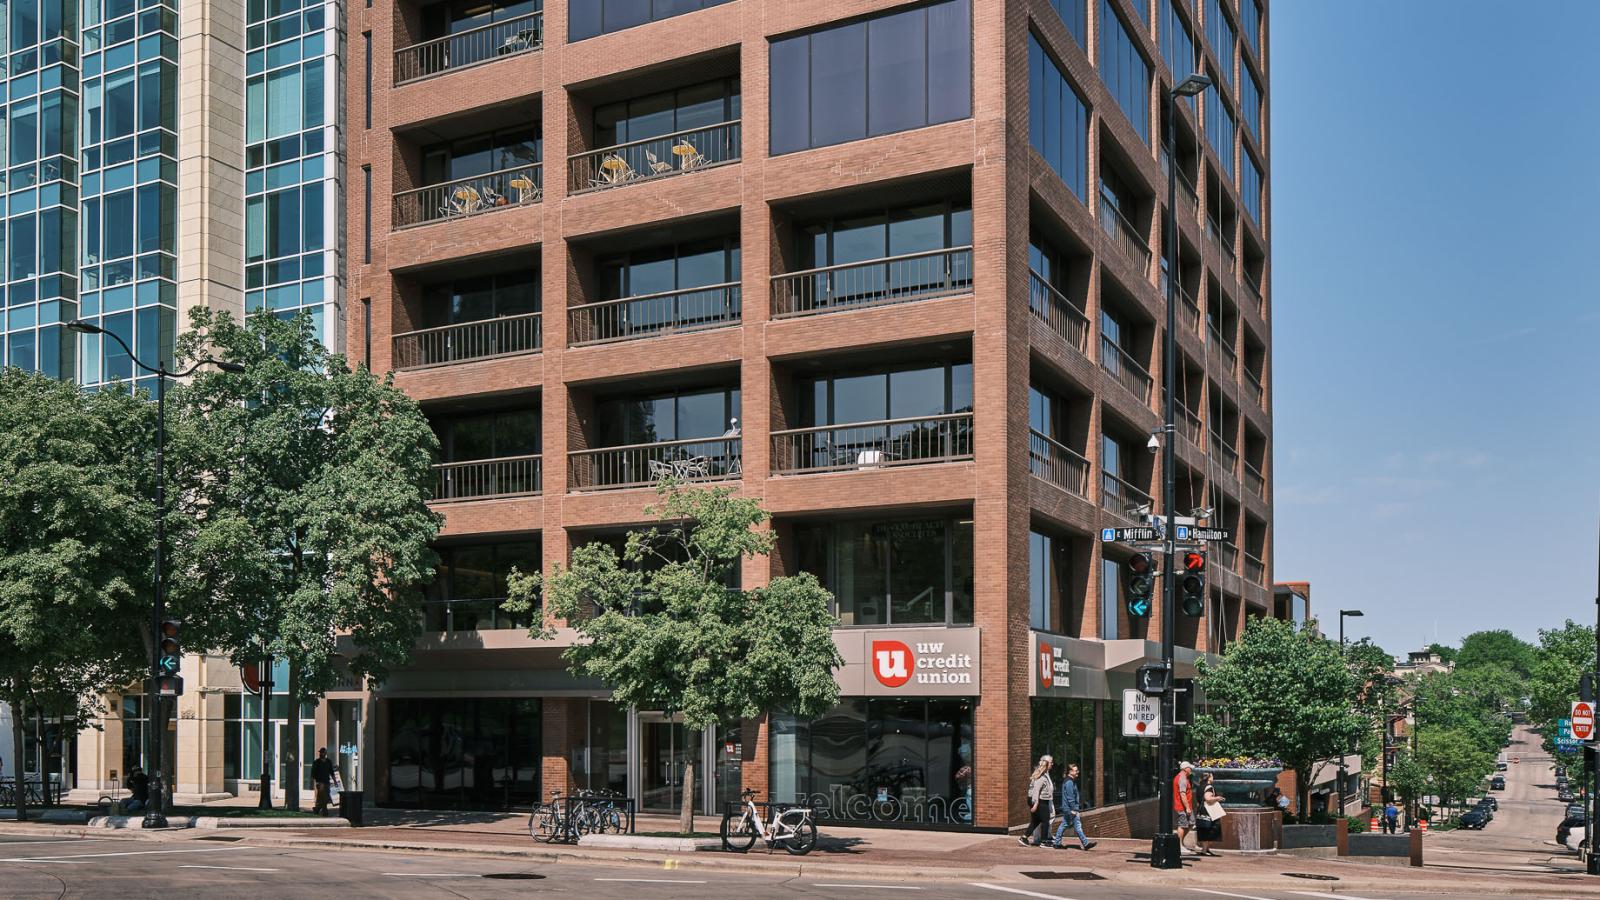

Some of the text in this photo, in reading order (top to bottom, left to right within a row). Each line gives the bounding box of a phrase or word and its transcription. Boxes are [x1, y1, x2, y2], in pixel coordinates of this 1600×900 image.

[1124, 529, 1152, 539] Mifflin
[1193, 528, 1222, 540] Hamilton
[916, 642, 944, 654] uw
[916, 654, 971, 669] credit
[1053, 659, 1070, 673] credit
[916, 670, 971, 684] union
[1136, 694, 1147, 703] NO
[1133, 704, 1151, 712] TURN
[1128, 713, 1155, 721] ON RED
[769, 784, 975, 824] elcome
